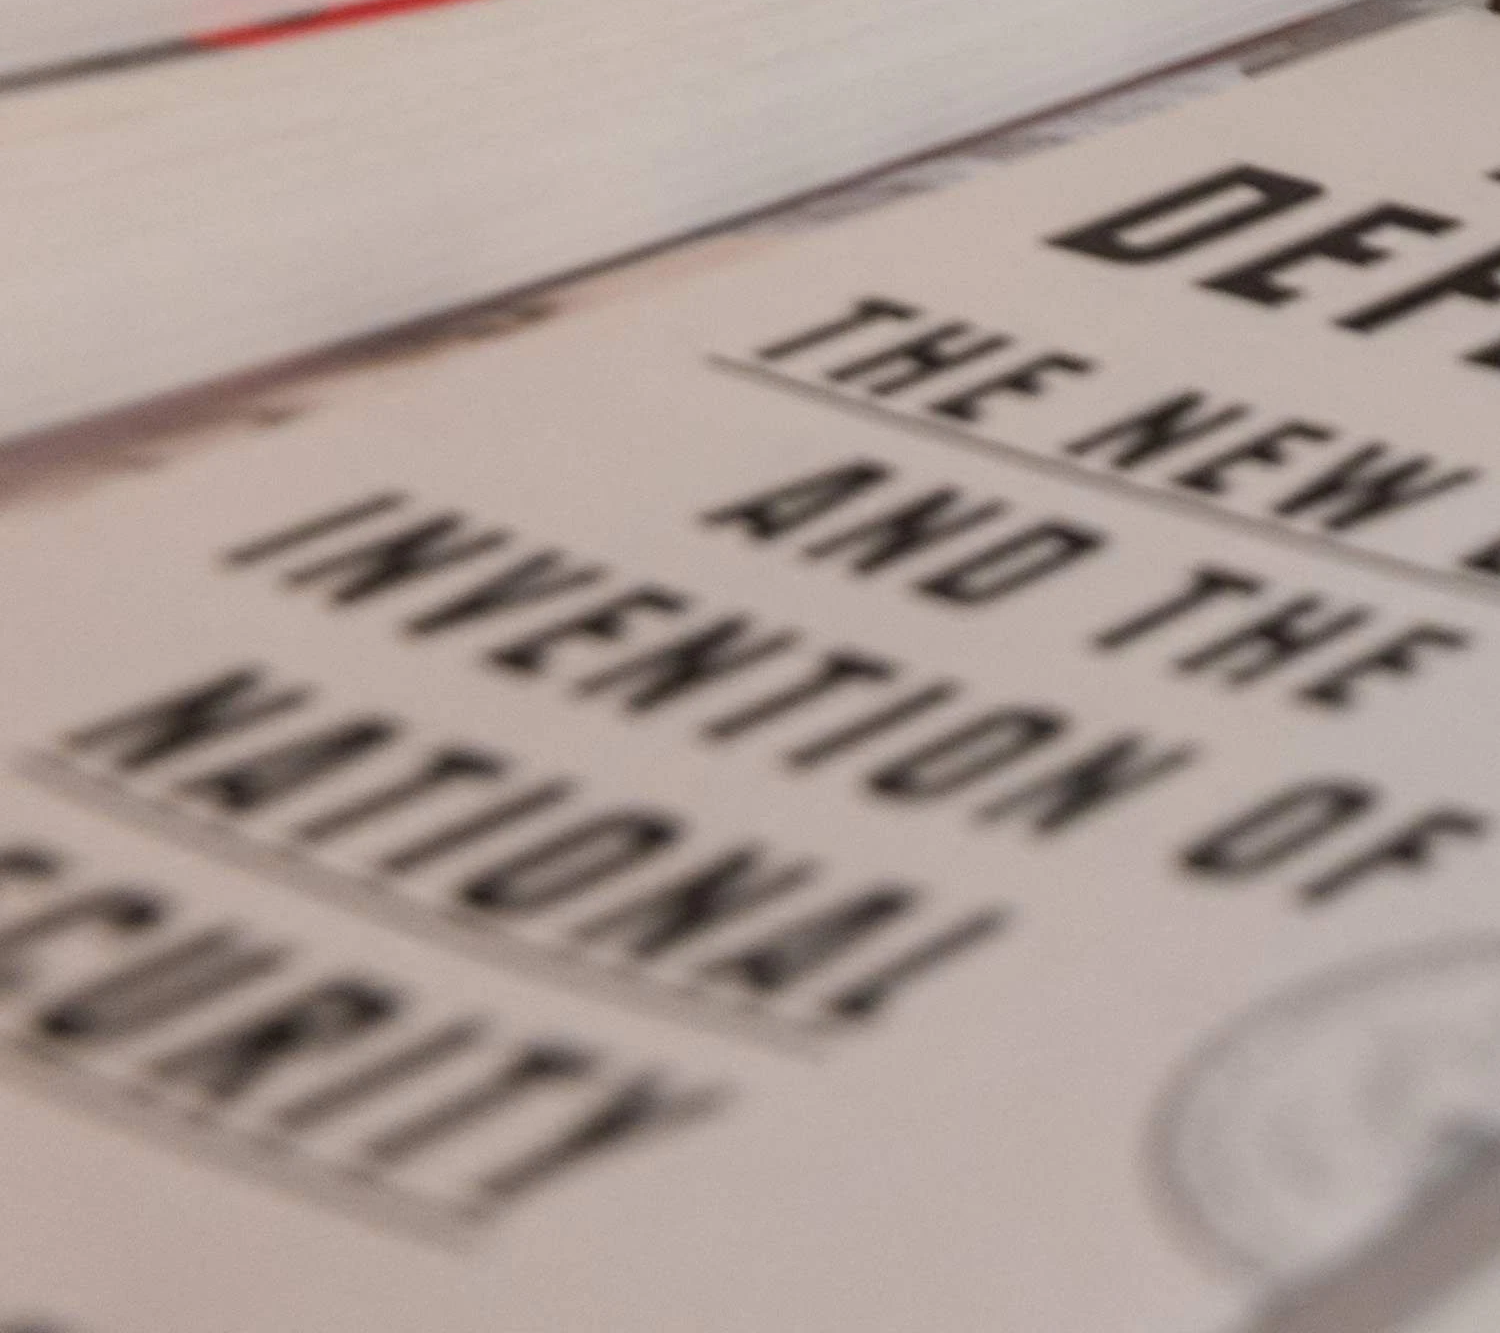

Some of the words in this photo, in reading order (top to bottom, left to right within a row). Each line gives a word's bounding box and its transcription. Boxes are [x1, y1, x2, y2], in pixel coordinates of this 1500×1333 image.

[755, 296, 1101, 423] THE
[1064, 388, 1482, 532] NEW
[218, 491, 1206, 837] INVENTION
[1180, 776, 1496, 910] OF
[696, 457, 1107, 607] AND
[1089, 563, 1477, 713] THE
[58, 663, 1012, 1023] NATIONAL
